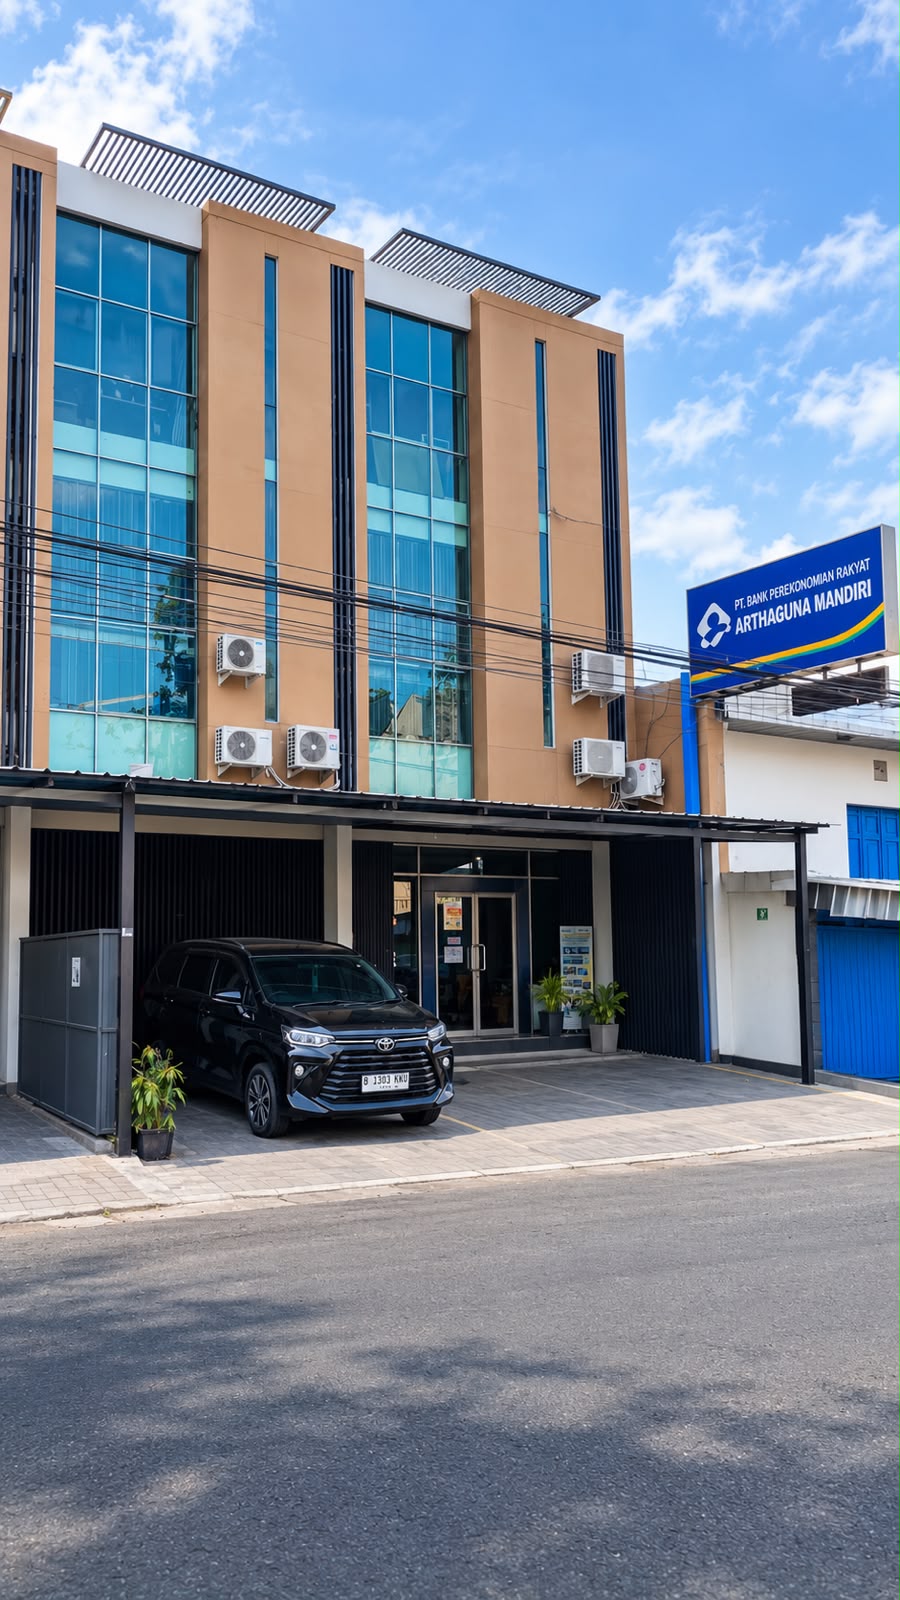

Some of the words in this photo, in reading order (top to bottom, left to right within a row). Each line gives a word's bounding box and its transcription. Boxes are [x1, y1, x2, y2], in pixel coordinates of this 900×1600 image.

[734, 597, 746, 611] PT.
[747, 590, 769, 608] BANK
[769, 569, 835, 601] PEREKONOMIAN
[836, 557, 871, 580] RAKYAT
[735, 597, 812, 635] ARTHAGUNA
[814, 578, 872, 612] MANDIRI
[363, 1076, 369, 1086] B
